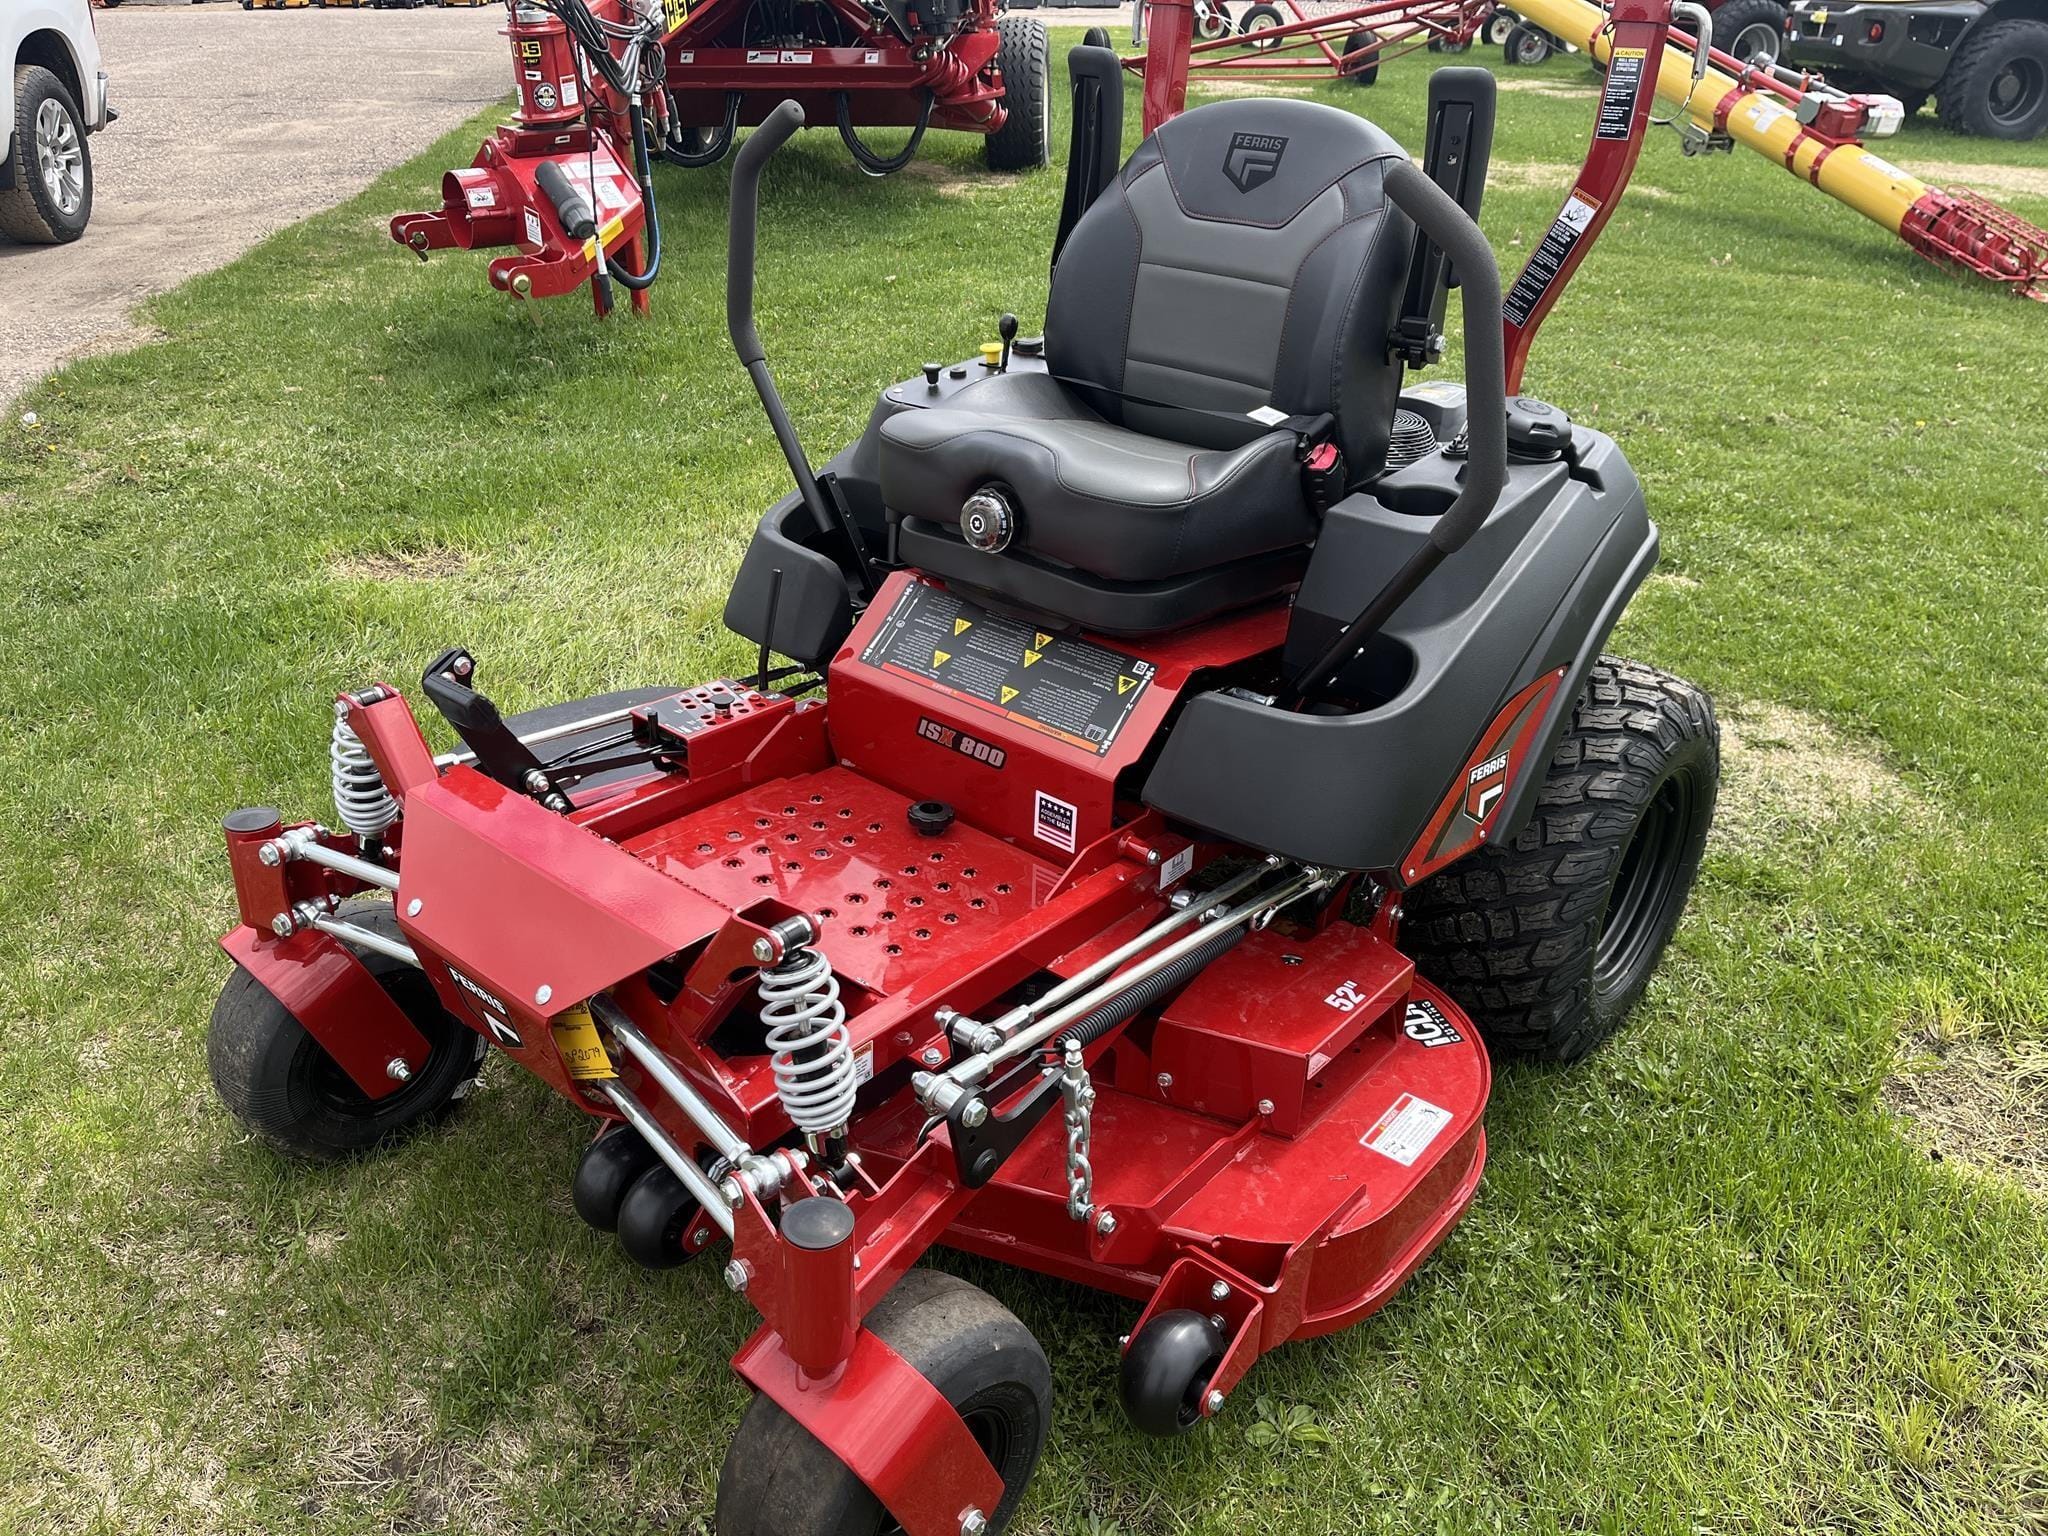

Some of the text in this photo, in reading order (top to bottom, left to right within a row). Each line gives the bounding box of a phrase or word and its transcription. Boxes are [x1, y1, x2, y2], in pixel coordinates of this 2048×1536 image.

[1235, 135, 1283, 150] FERRIS
[918, 719, 1005, 767] ISX 800
[1470, 754, 1507, 784] FERRIS
[1040, 808, 1071, 825] ASSEMBLED
[1056, 820, 1070, 831] USA
[448, 967, 507, 1015] FERRIS
[1323, 980, 1367, 1012] 52"
[1421, 1001, 1461, 1043] CUTTING
